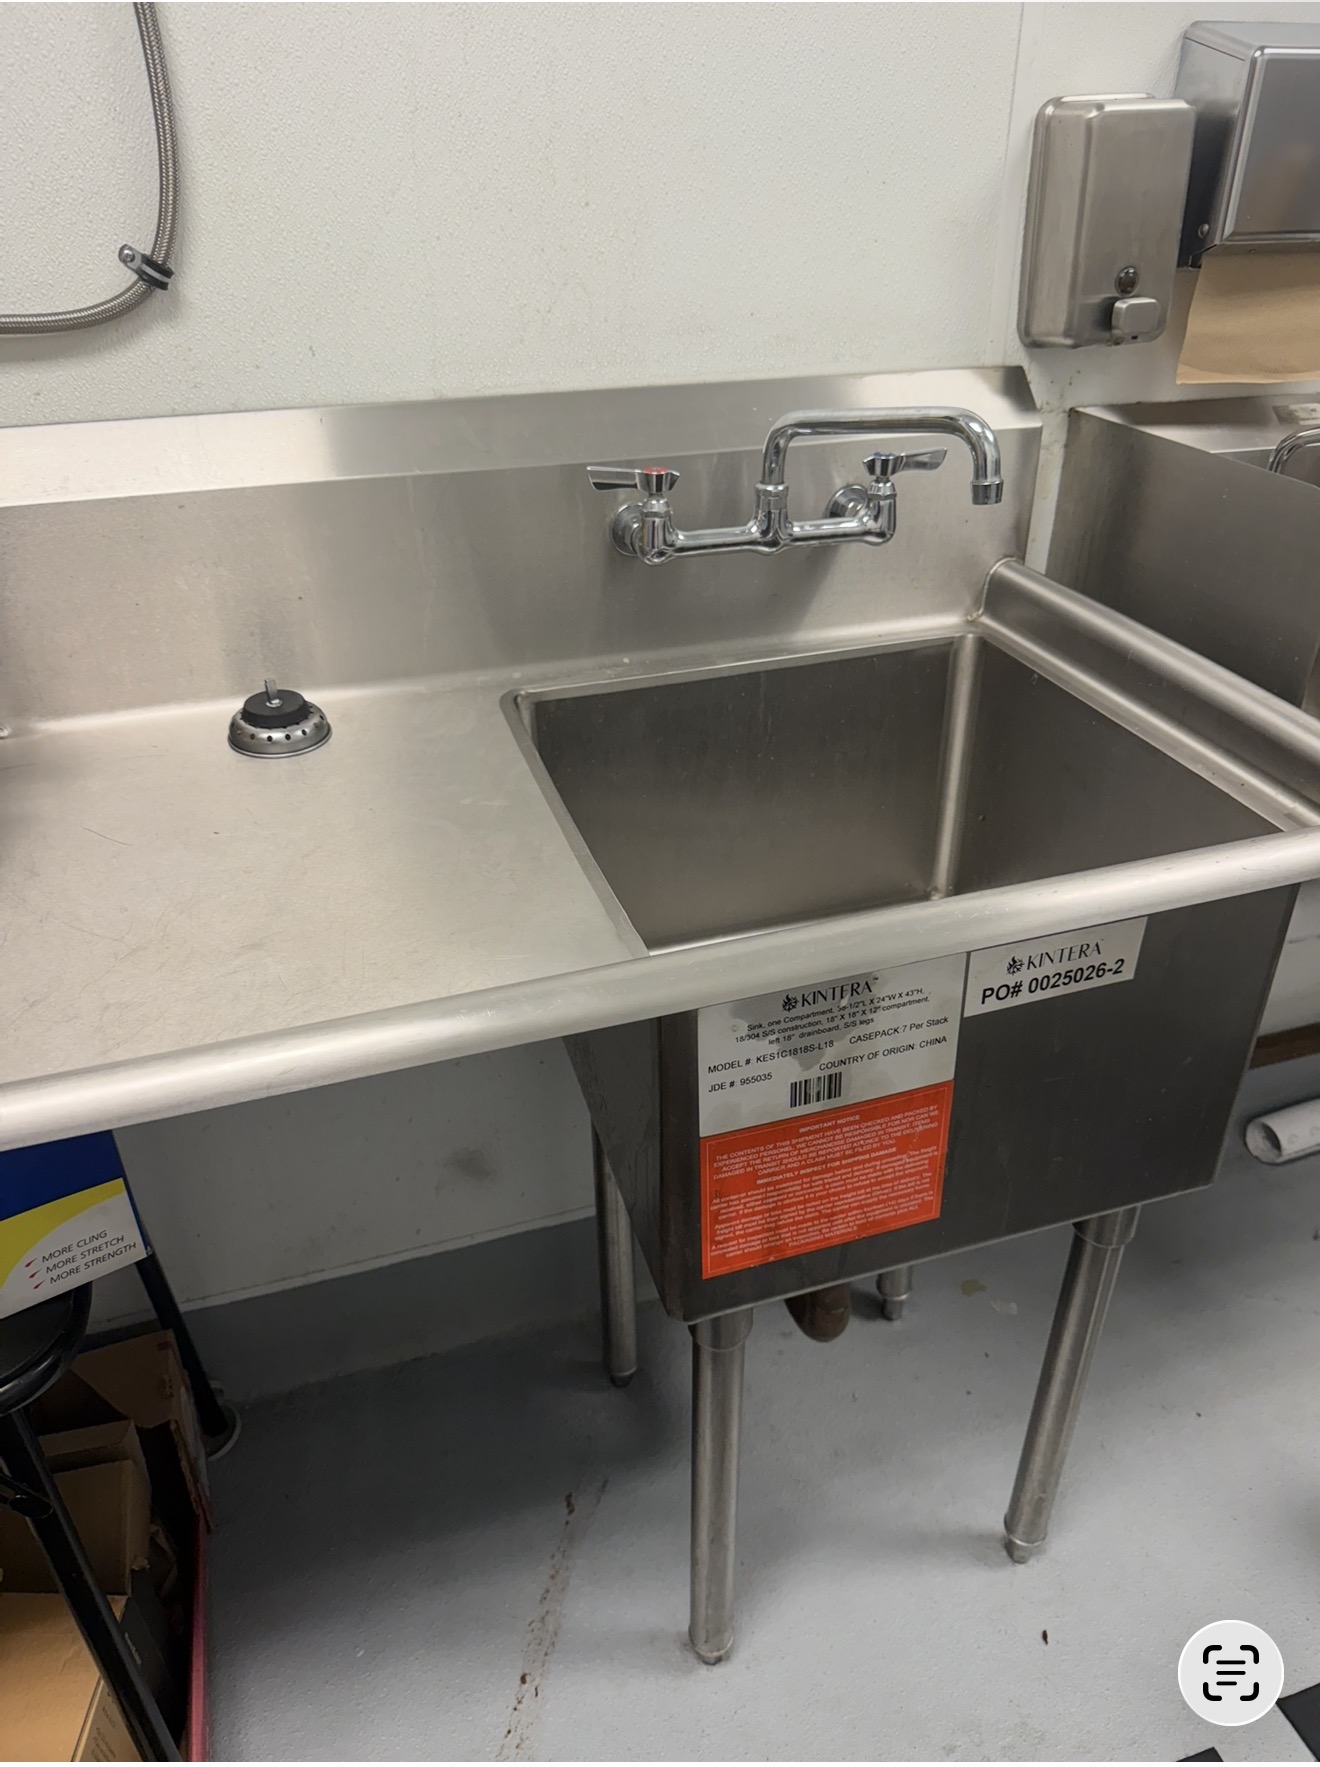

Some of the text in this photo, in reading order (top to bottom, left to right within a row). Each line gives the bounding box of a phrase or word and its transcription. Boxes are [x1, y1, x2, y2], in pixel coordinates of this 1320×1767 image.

[1027, 941, 1102, 970] KINTERA
[801, 979, 873, 1008] KINTERA
[981, 958, 1125, 1004] PO# 0025026-2
[736, 1033, 760, 1044] 18/304
[762, 1029, 776, 1038] S/S
[777, 1019, 823, 1035] construction,
[748, 1022, 765, 1032] Sink,
[767, 1019, 781, 1028] one
[783, 1007, 835, 1024] Compartment,
[769, 1038, 780, 1046] left
[799, 1025, 841, 1039] drainboard,
[844, 1021, 857, 1029] S/S
[859, 1018, 874, 1026] legs
[910, 1022, 924, 1031] Per
[926, 1016, 949, 1028] Stack
[708, 1060, 743, 1074] MODEL
[756, 1040, 834, 1064] KES1C1818S-L18
[819, 1054, 865, 1071] COUNTRY
[867, 1051, 879, 1061] OF
[919, 1036, 948, 1049] CHINA
[708, 1082, 726, 1093] JDE
[740, 1072, 772, 1086] 955035
[799, 1116, 860, 1134] IMPORTANT NOTICE
[757, 1172, 798, 1185] IMMEDIATELY
[800, 1165, 826, 1175] INSPECT
[841, 1154, 869, 1165] SHIPPING
[871, 1148, 897, 1158] DAMAGE
[42, 1230, 108, 1263] MORE CLING
[46, 1235, 124, 1274] MORE STRETCH
[50, 1242, 137, 1284] MORE STRENGTH
